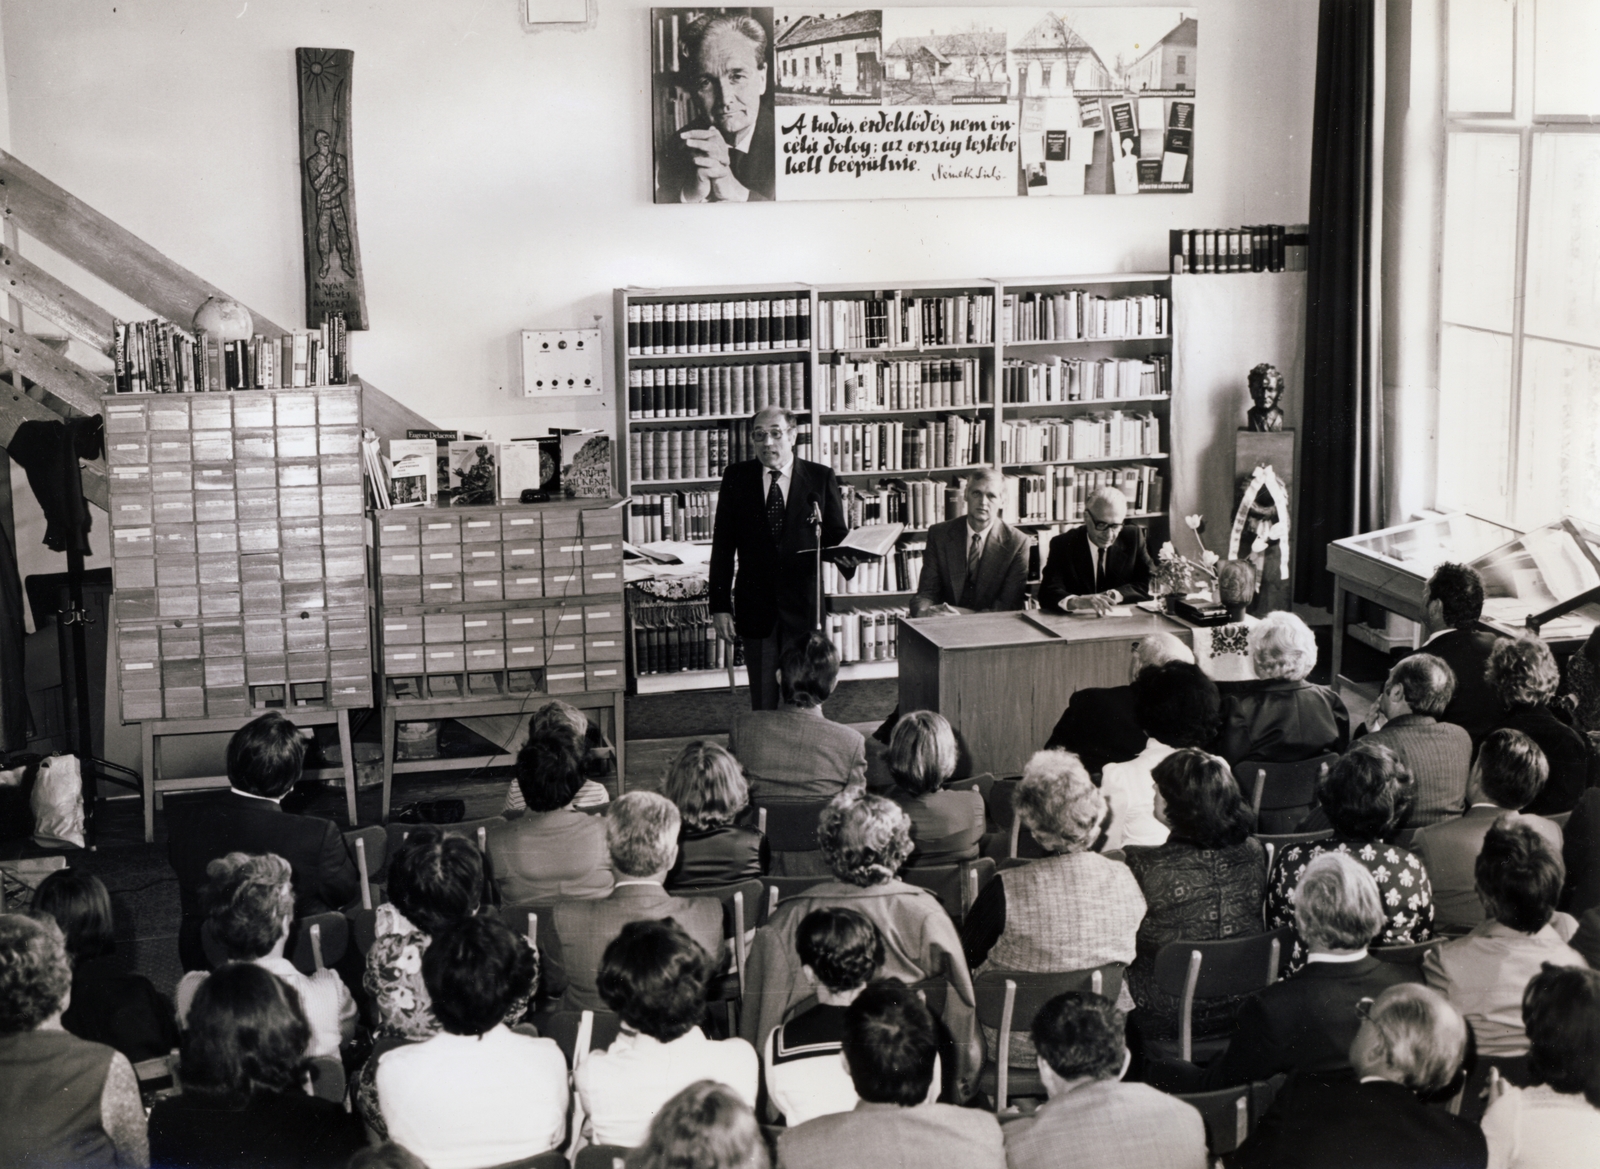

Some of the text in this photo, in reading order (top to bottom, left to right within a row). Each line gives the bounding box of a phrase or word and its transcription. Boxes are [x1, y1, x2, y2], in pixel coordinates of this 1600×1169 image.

[781, 112, 807, 136] A
[949, 118, 988, 132] nem
[881, 138, 904, 153] az
[907, 135, 963, 159] ország
[965, 132, 1018, 155] testébe
[785, 154, 824, 176] kell
[115, 336, 125, 377] Webster's
[408, 431, 457, 440] Eugène Delacroix
